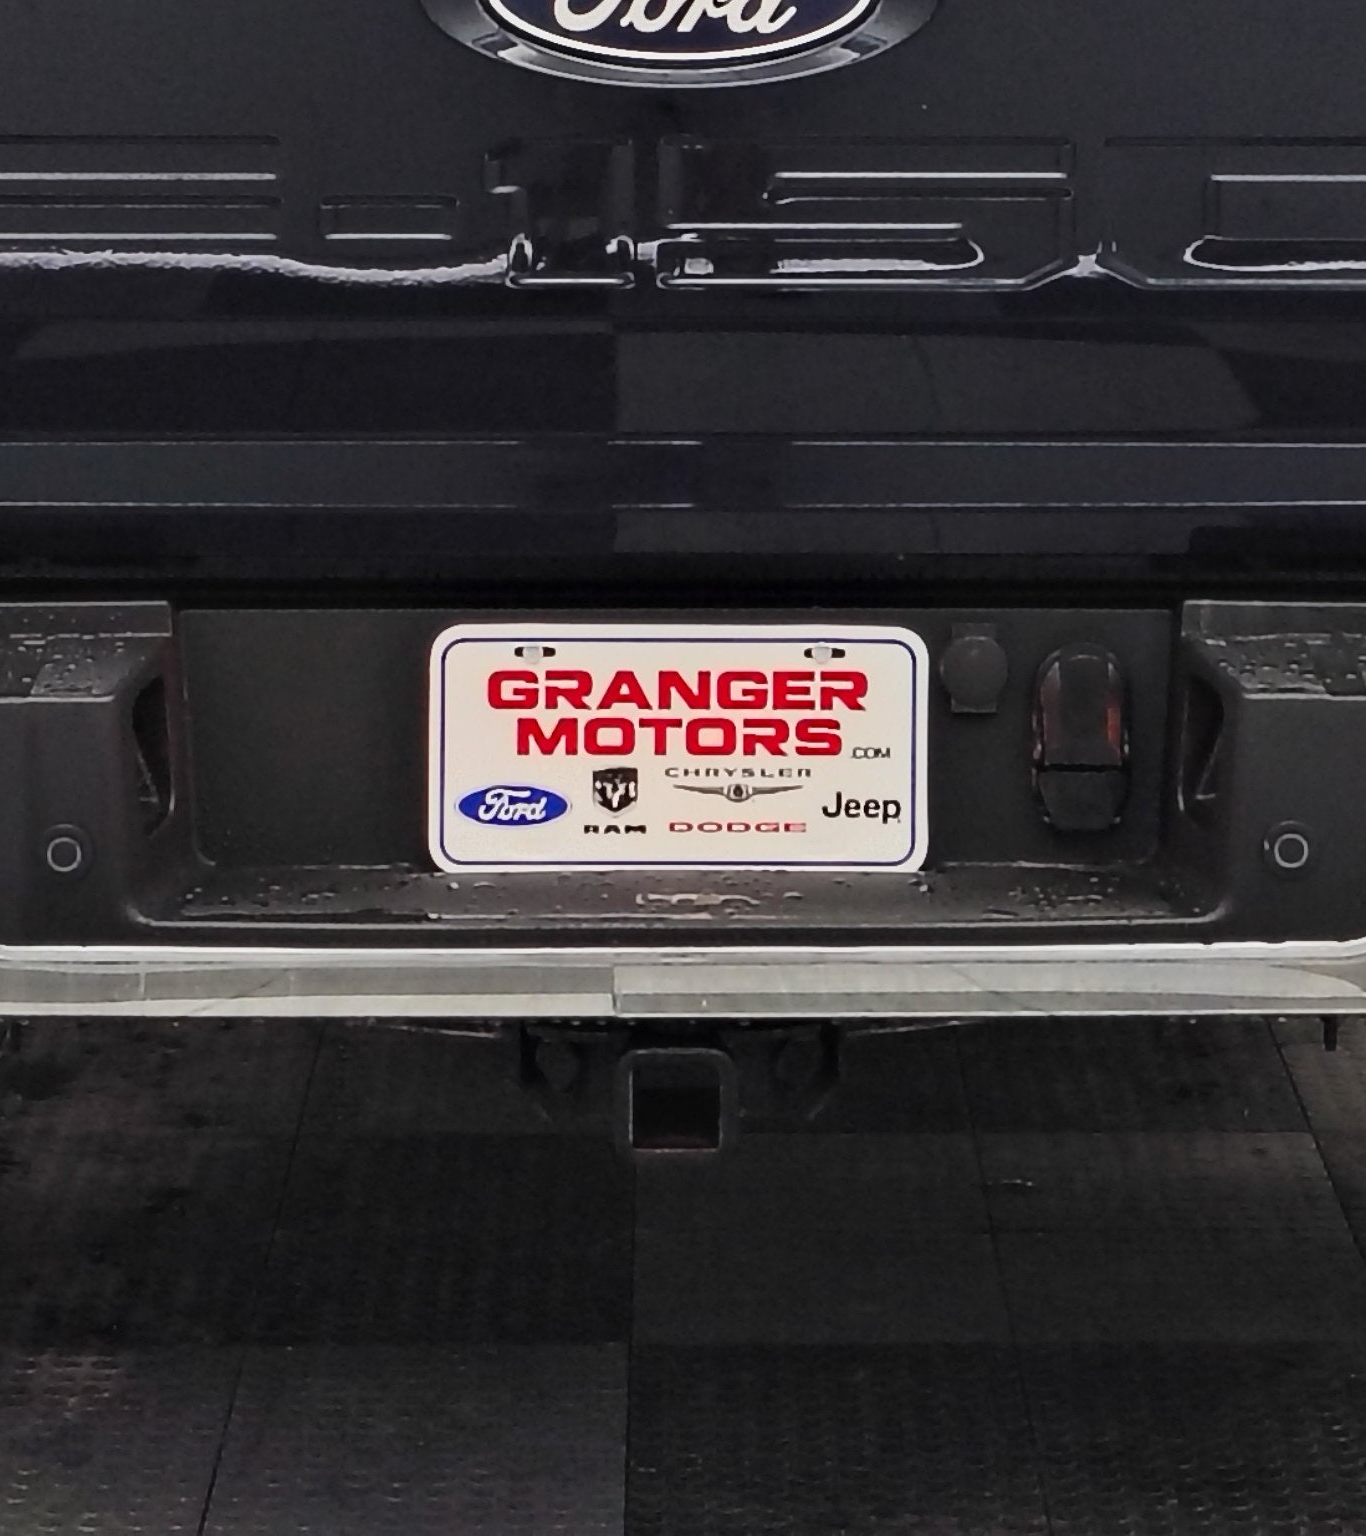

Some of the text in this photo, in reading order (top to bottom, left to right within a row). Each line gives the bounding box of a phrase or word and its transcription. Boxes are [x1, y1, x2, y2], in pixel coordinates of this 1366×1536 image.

[487, 669, 868, 711] GRANGER
[516, 717, 842, 756] MOTORS
[664, 767, 812, 778] CHRYSLER
[477, 788, 548, 822] Ford
[821, 791, 902, 823] Jeep
[583, 823, 647, 834] RAM
[668, 821, 807, 833] DODGE
